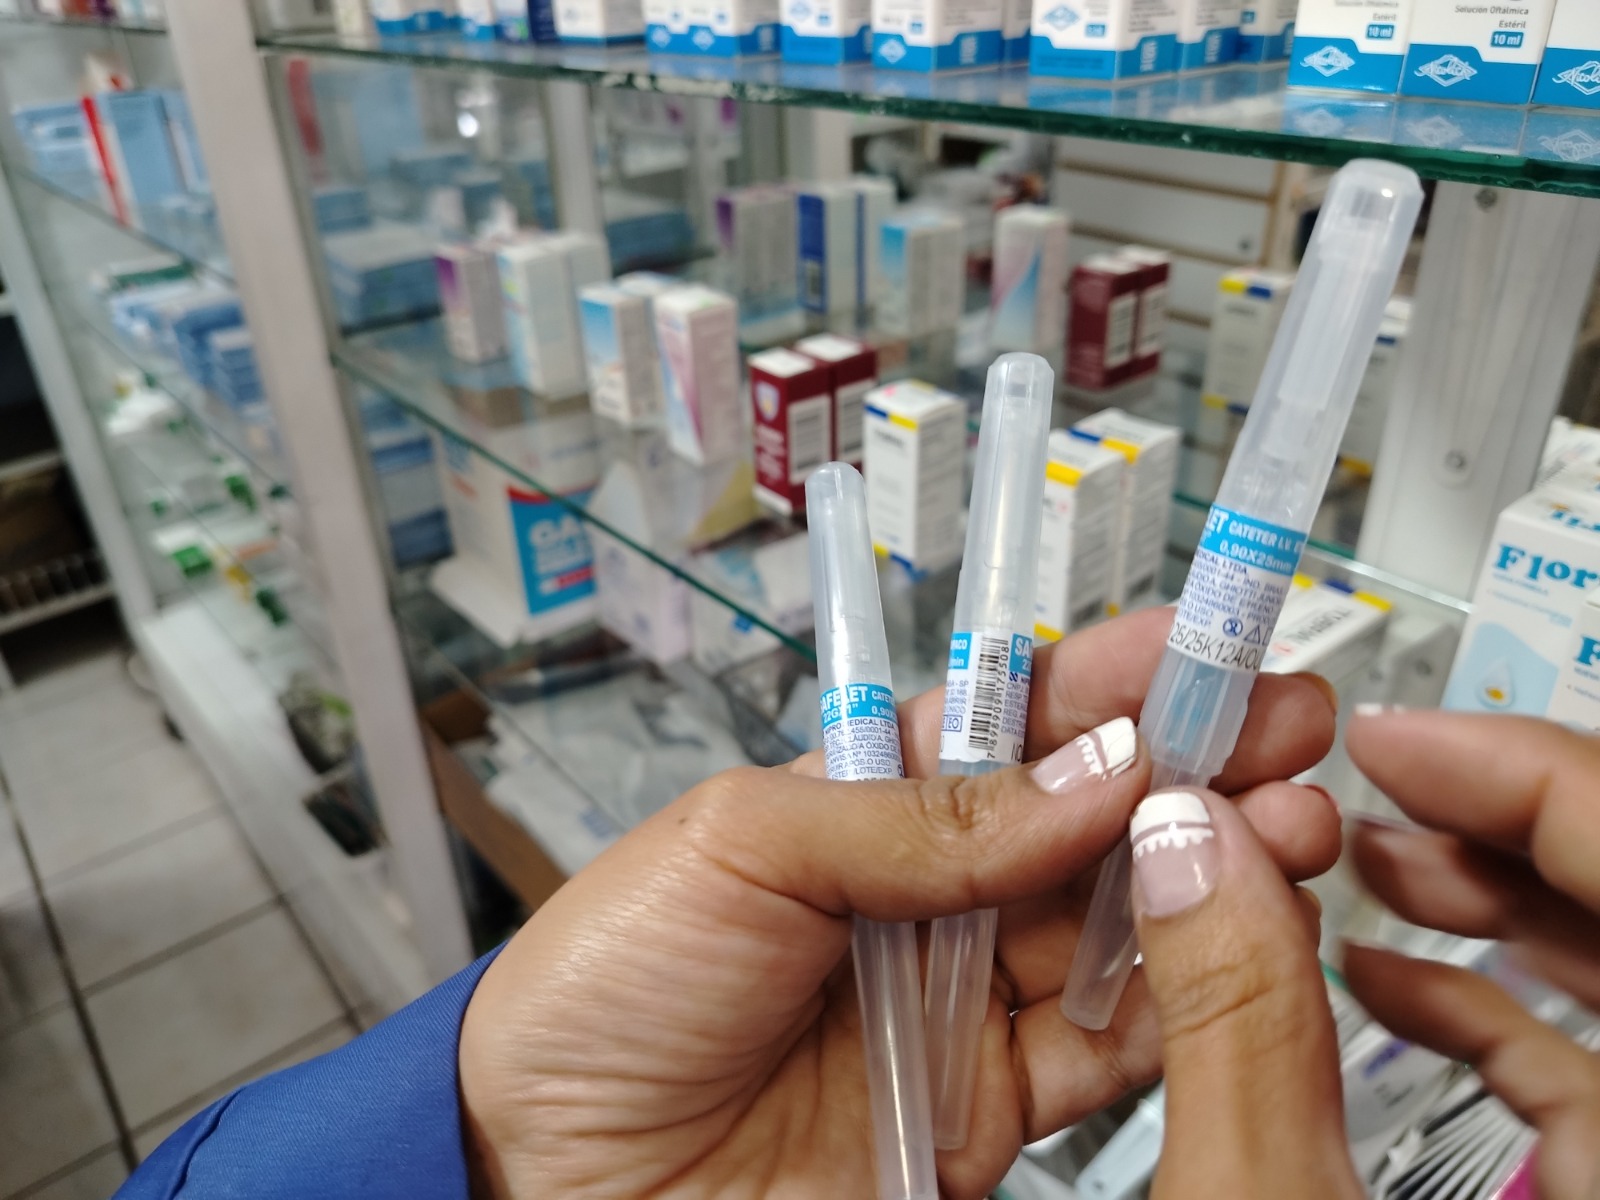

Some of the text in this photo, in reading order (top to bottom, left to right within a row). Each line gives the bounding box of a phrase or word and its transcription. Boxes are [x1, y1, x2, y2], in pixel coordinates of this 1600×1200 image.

[1490, 6, 1529, 15] Oftálmica
[1498, 20, 1526, 28] Estéril
[1493, 34, 1521, 45] 10 ml
[1228, 519, 1277, 547] CATETER
